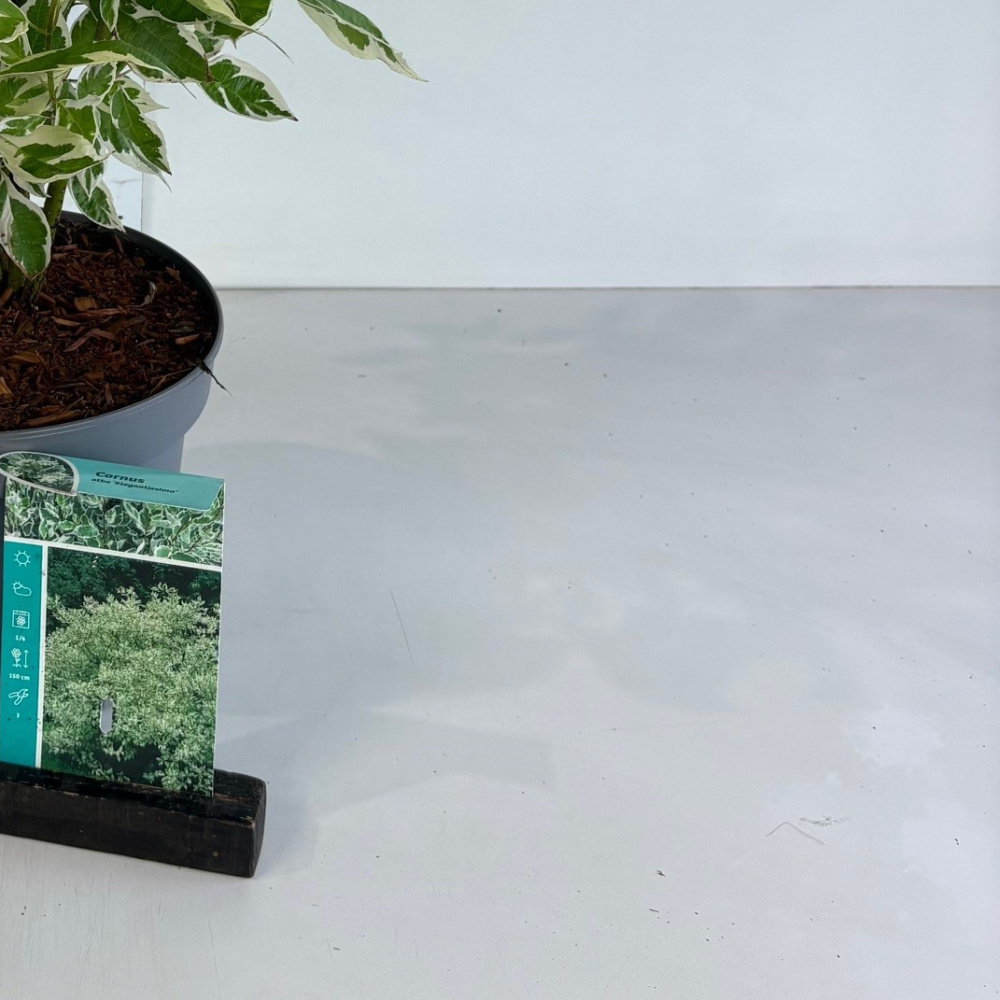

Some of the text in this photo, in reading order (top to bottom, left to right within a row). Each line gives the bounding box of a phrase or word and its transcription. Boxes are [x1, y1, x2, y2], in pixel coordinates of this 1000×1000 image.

[95, 471, 145, 483] Cornus
[15, 634, 26, 642] 5/6
[9, 672, 20, 680] 150
